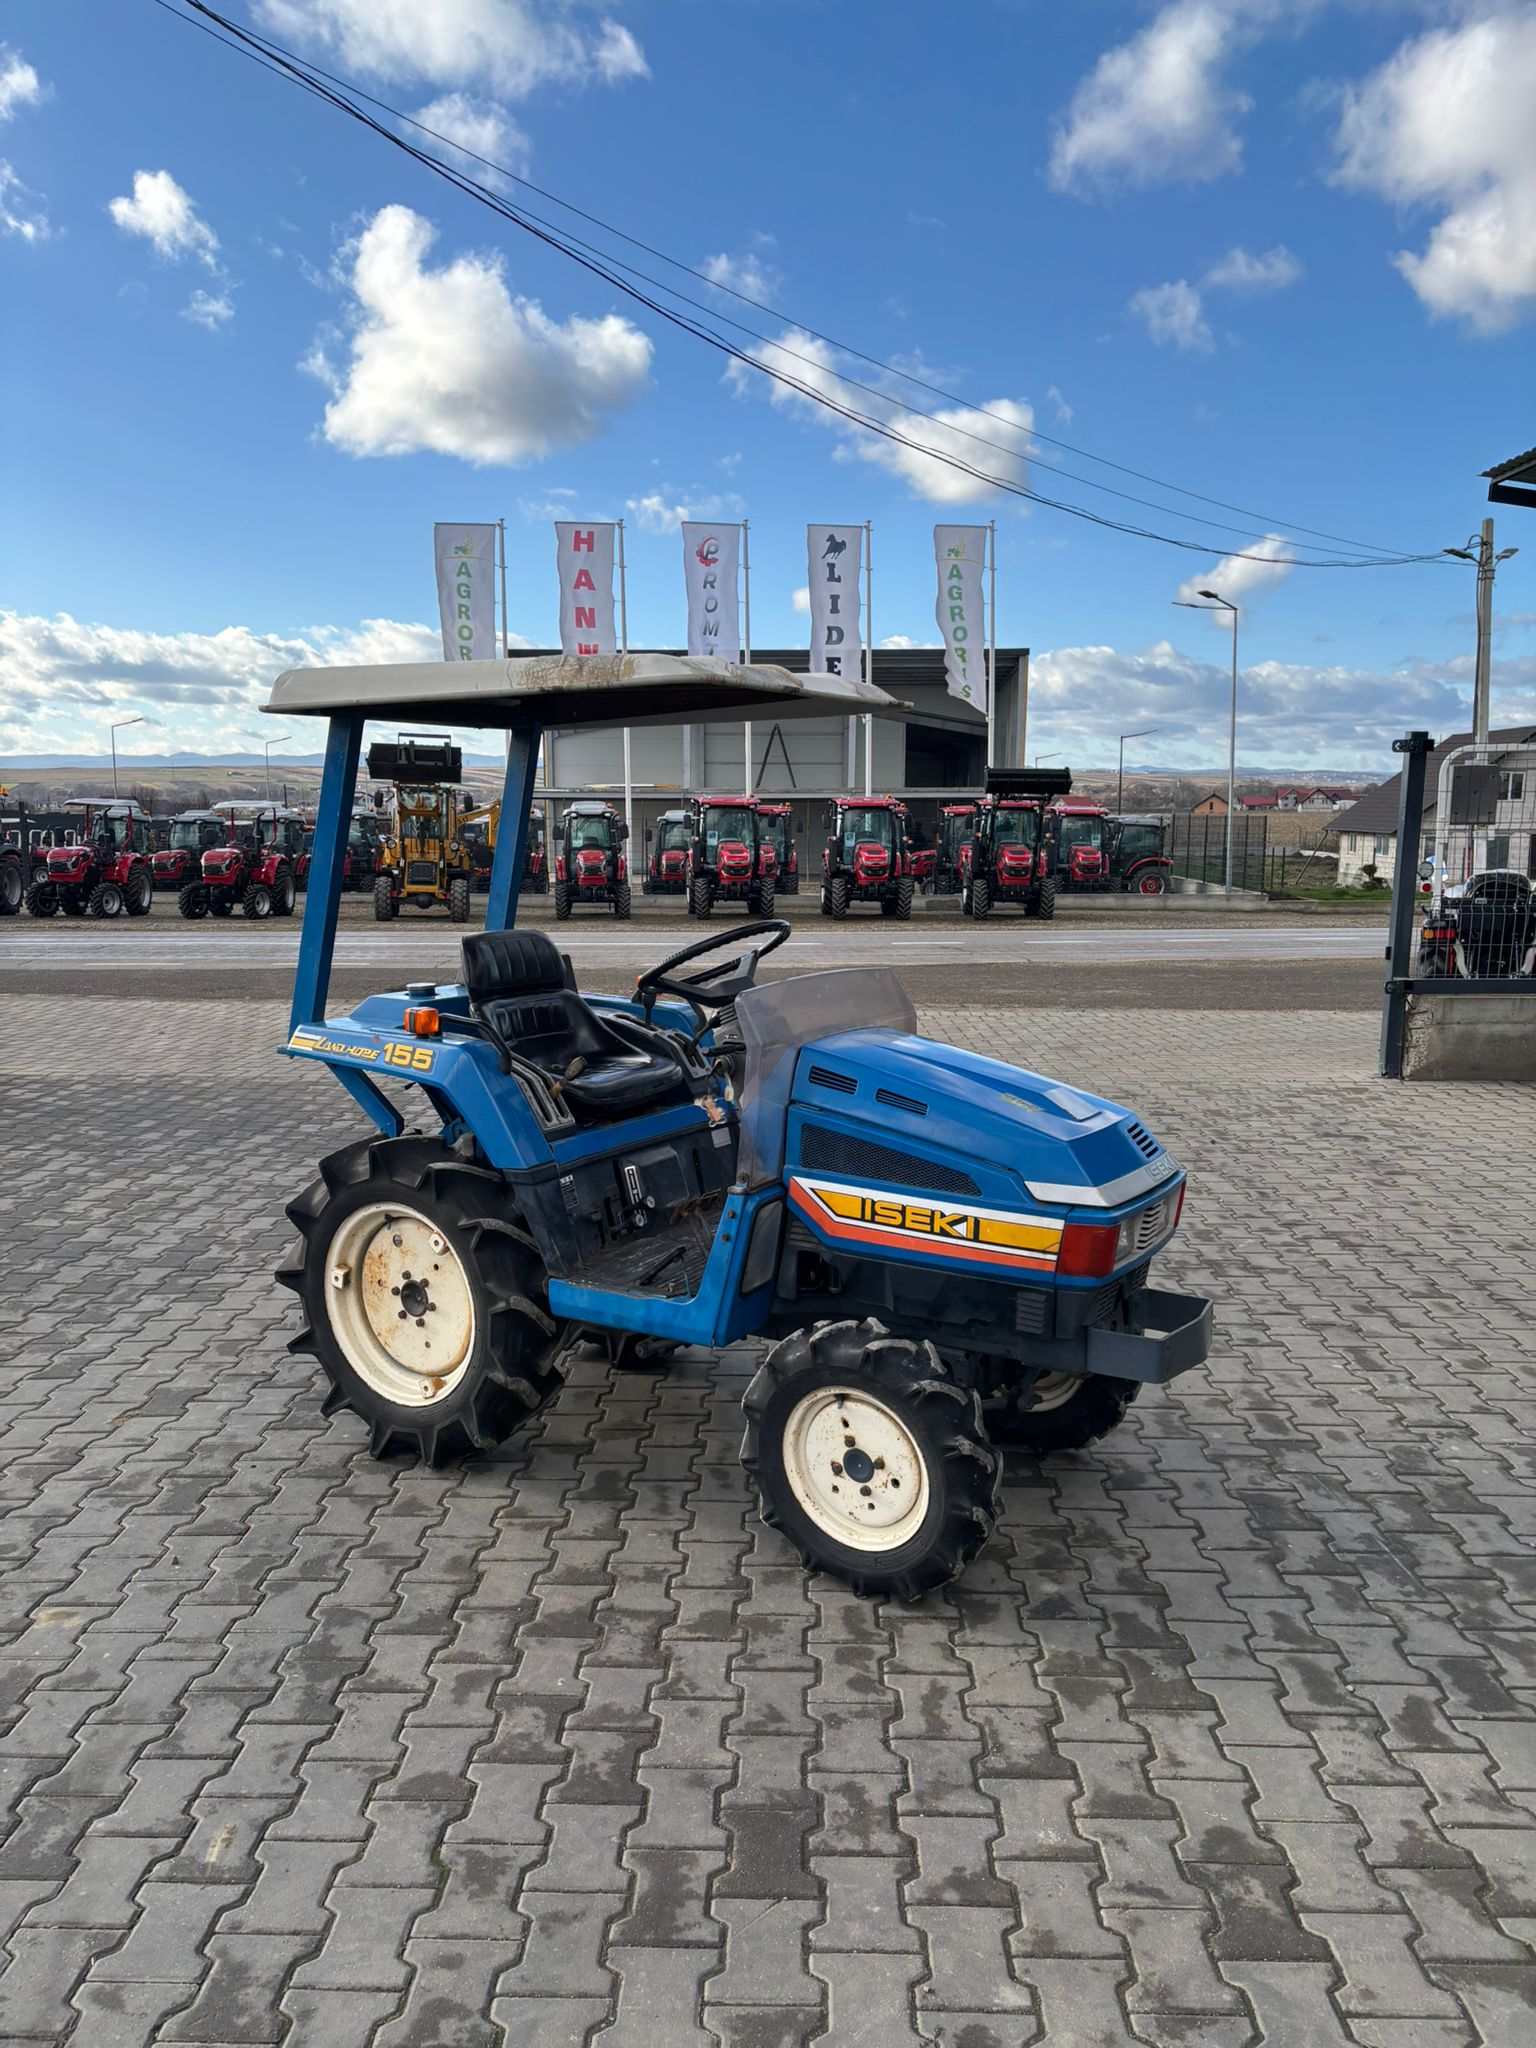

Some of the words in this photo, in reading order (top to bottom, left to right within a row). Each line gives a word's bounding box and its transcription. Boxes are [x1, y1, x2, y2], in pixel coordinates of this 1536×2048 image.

[456, 561, 474, 660] AGROR
[825, 563, 845, 676] LIDE
[948, 564, 972, 699] AGRORIS
[384, 1042, 434, 1072] 155
[863, 1197, 979, 1241] ISEKI
